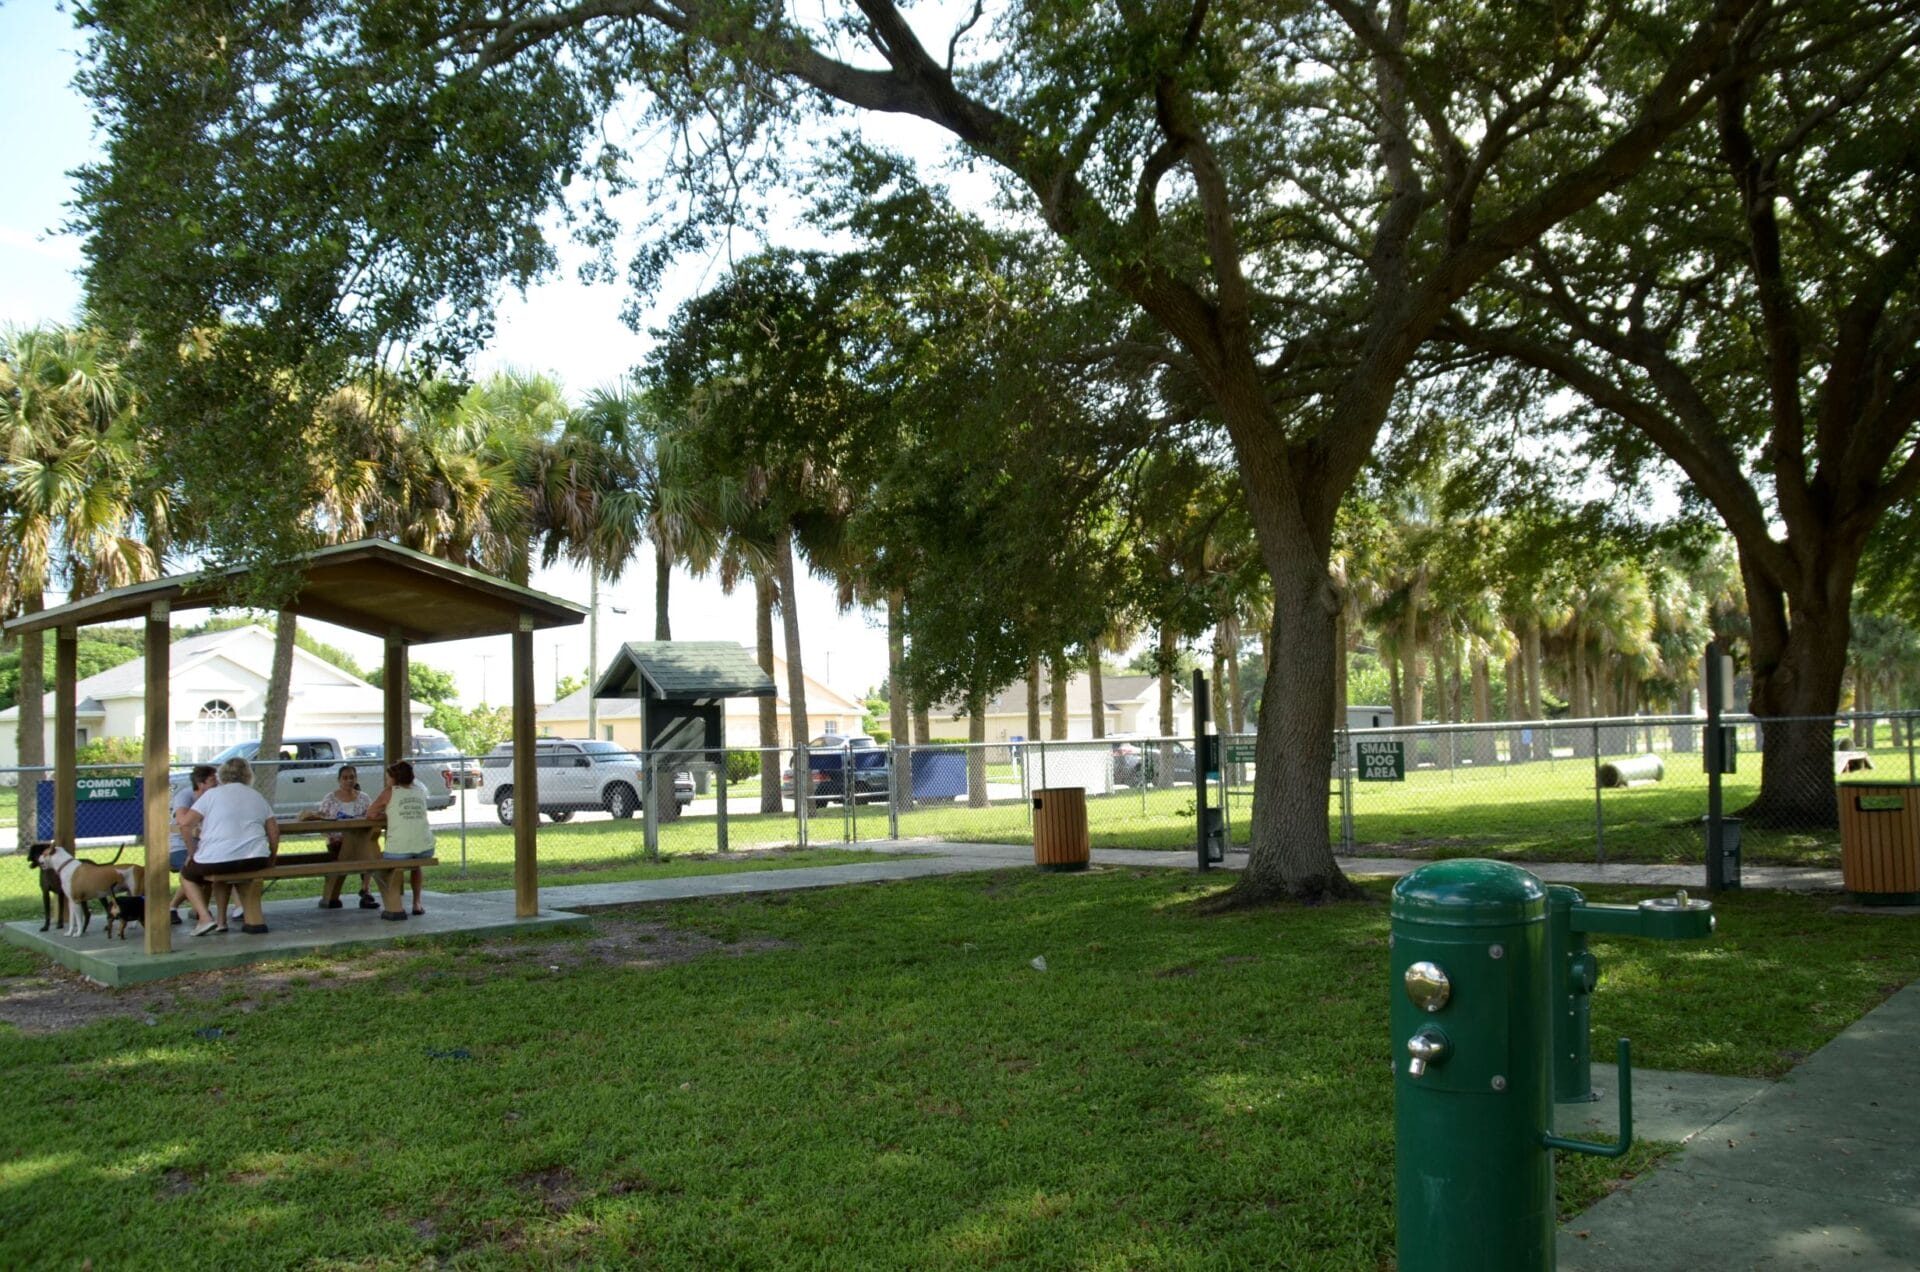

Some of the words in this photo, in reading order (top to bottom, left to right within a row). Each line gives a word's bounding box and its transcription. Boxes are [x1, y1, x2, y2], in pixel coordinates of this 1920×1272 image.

[1361, 742, 1399, 754] SMALL
[1366, 755, 1395, 766] DOG
[1366, 767, 1398, 778] AREA
[76, 778, 131, 789] COMMON
[88, 788, 119, 799] AREA
